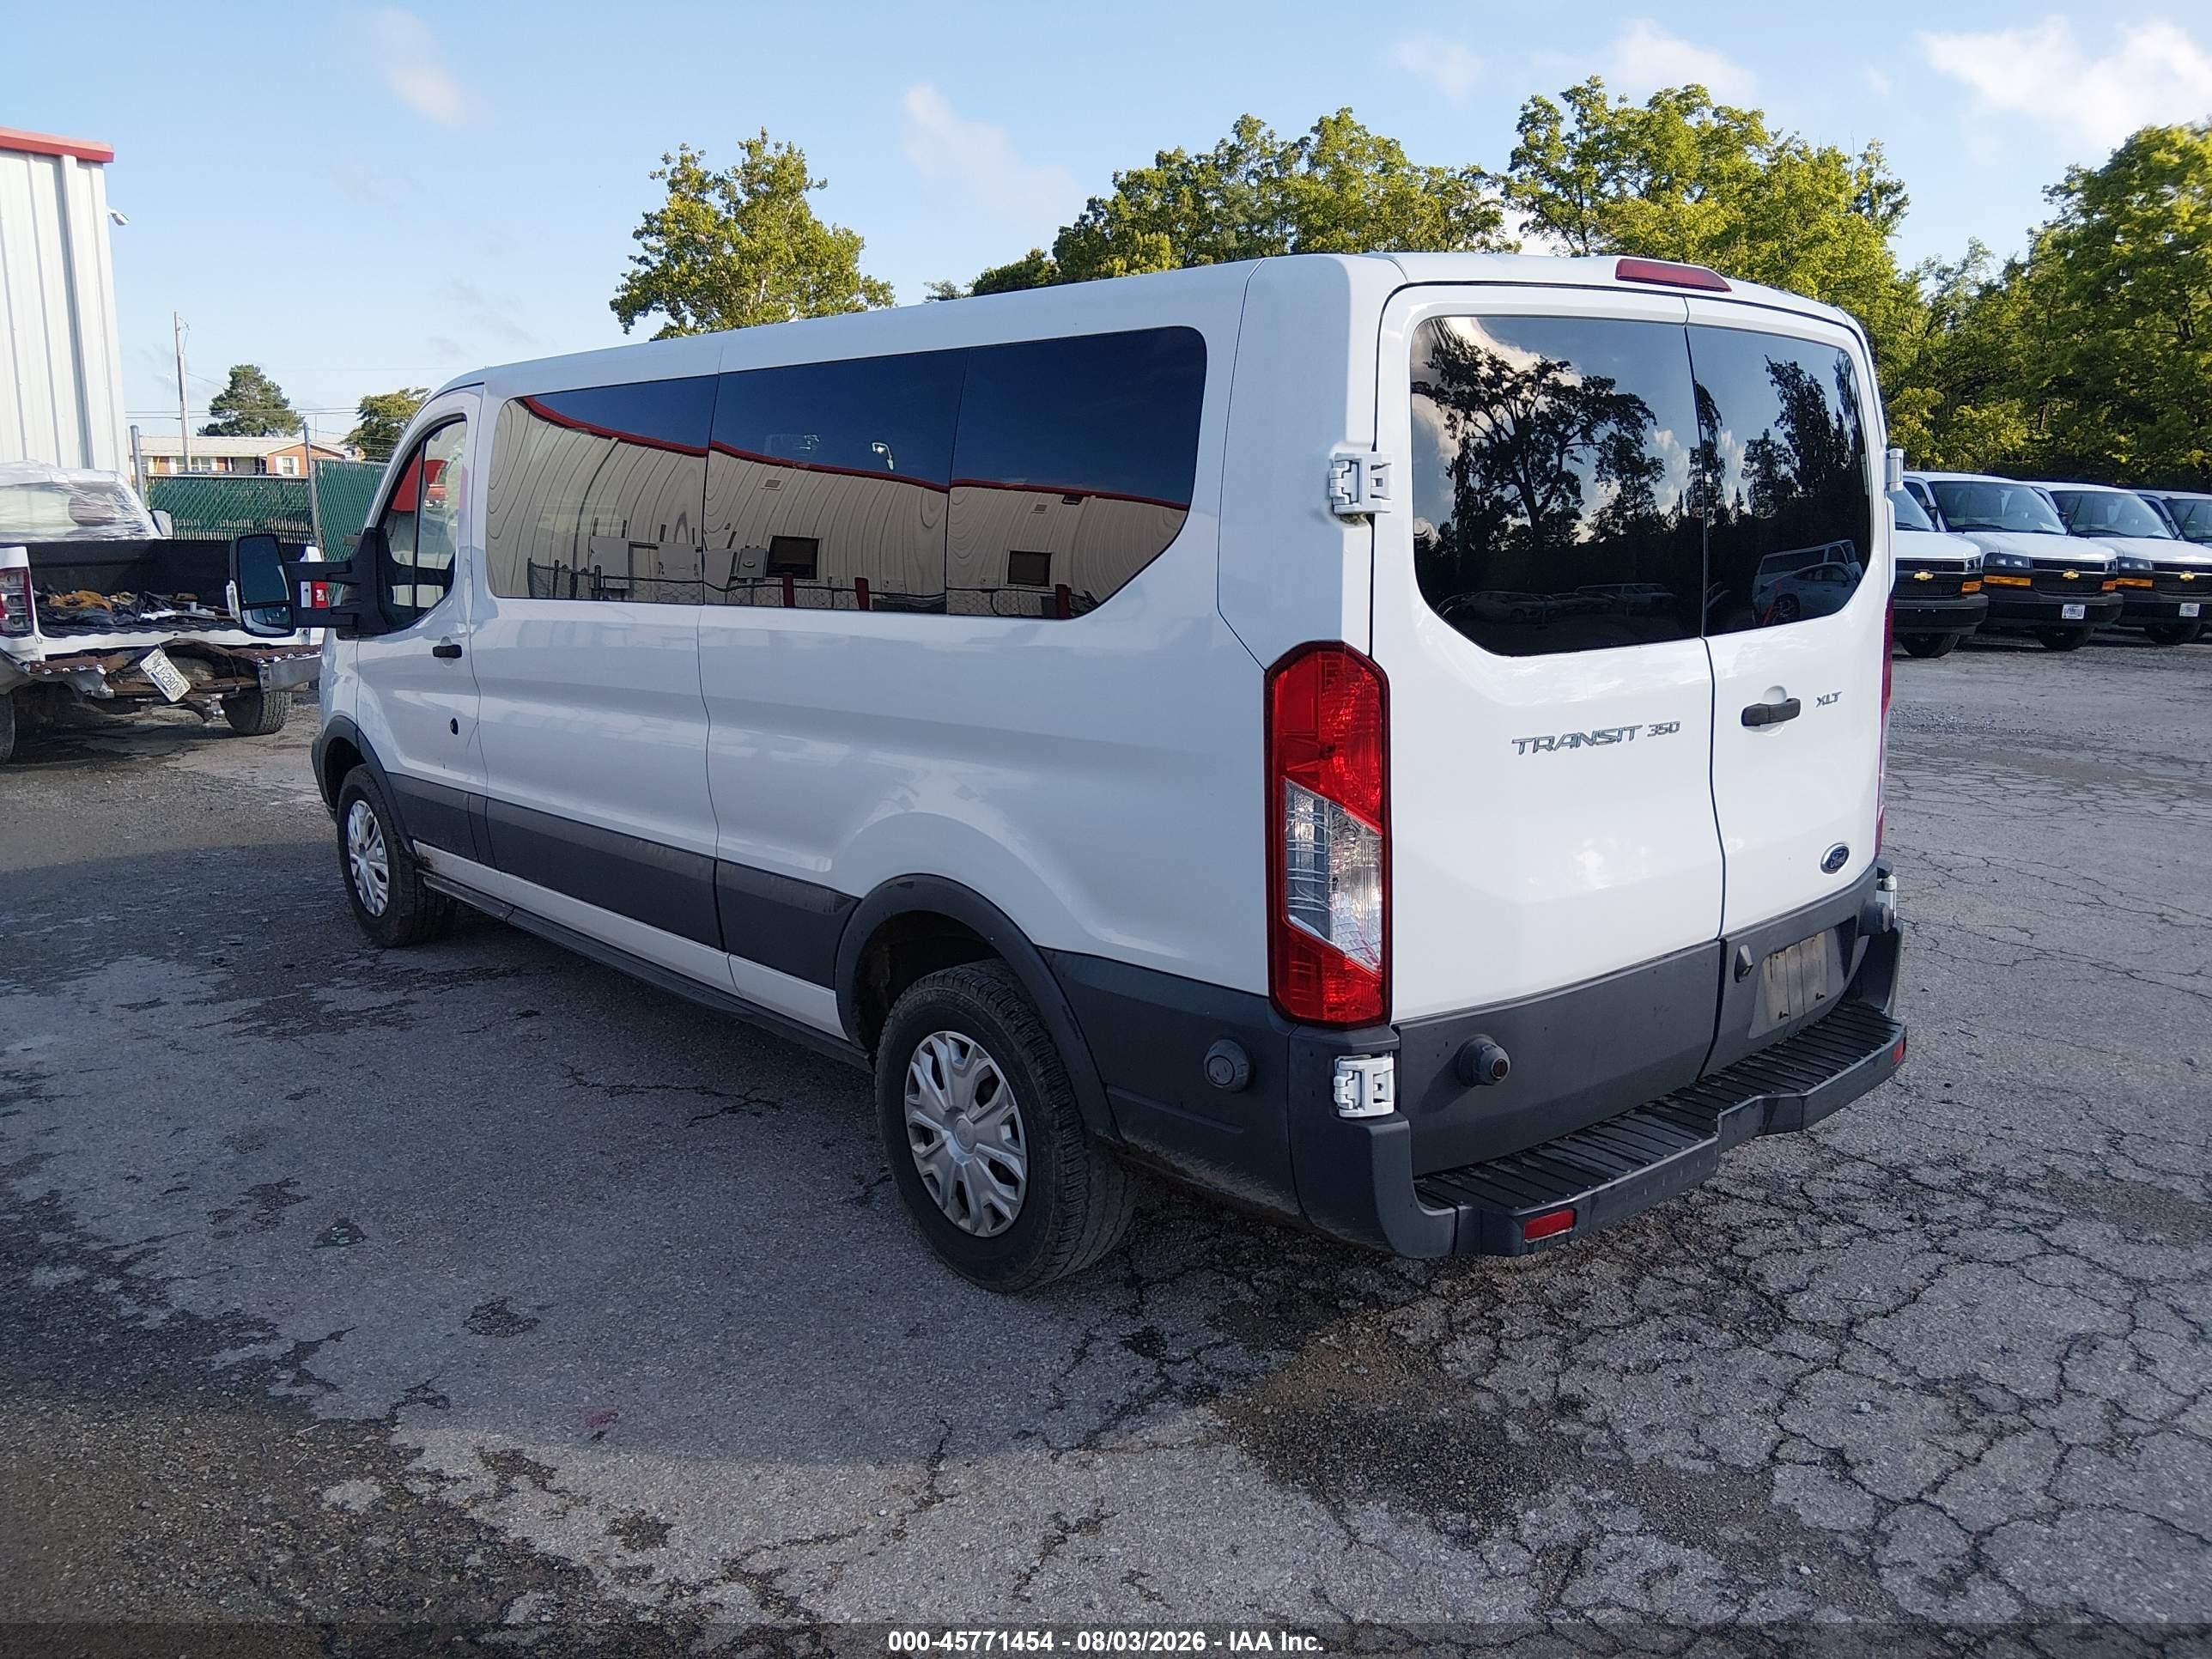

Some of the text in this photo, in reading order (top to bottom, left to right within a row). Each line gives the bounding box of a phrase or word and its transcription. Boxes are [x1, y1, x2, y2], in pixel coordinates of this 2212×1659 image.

[1815, 690, 1843, 708] XLT
[1511, 720, 1680, 756] TRANSIT 350
